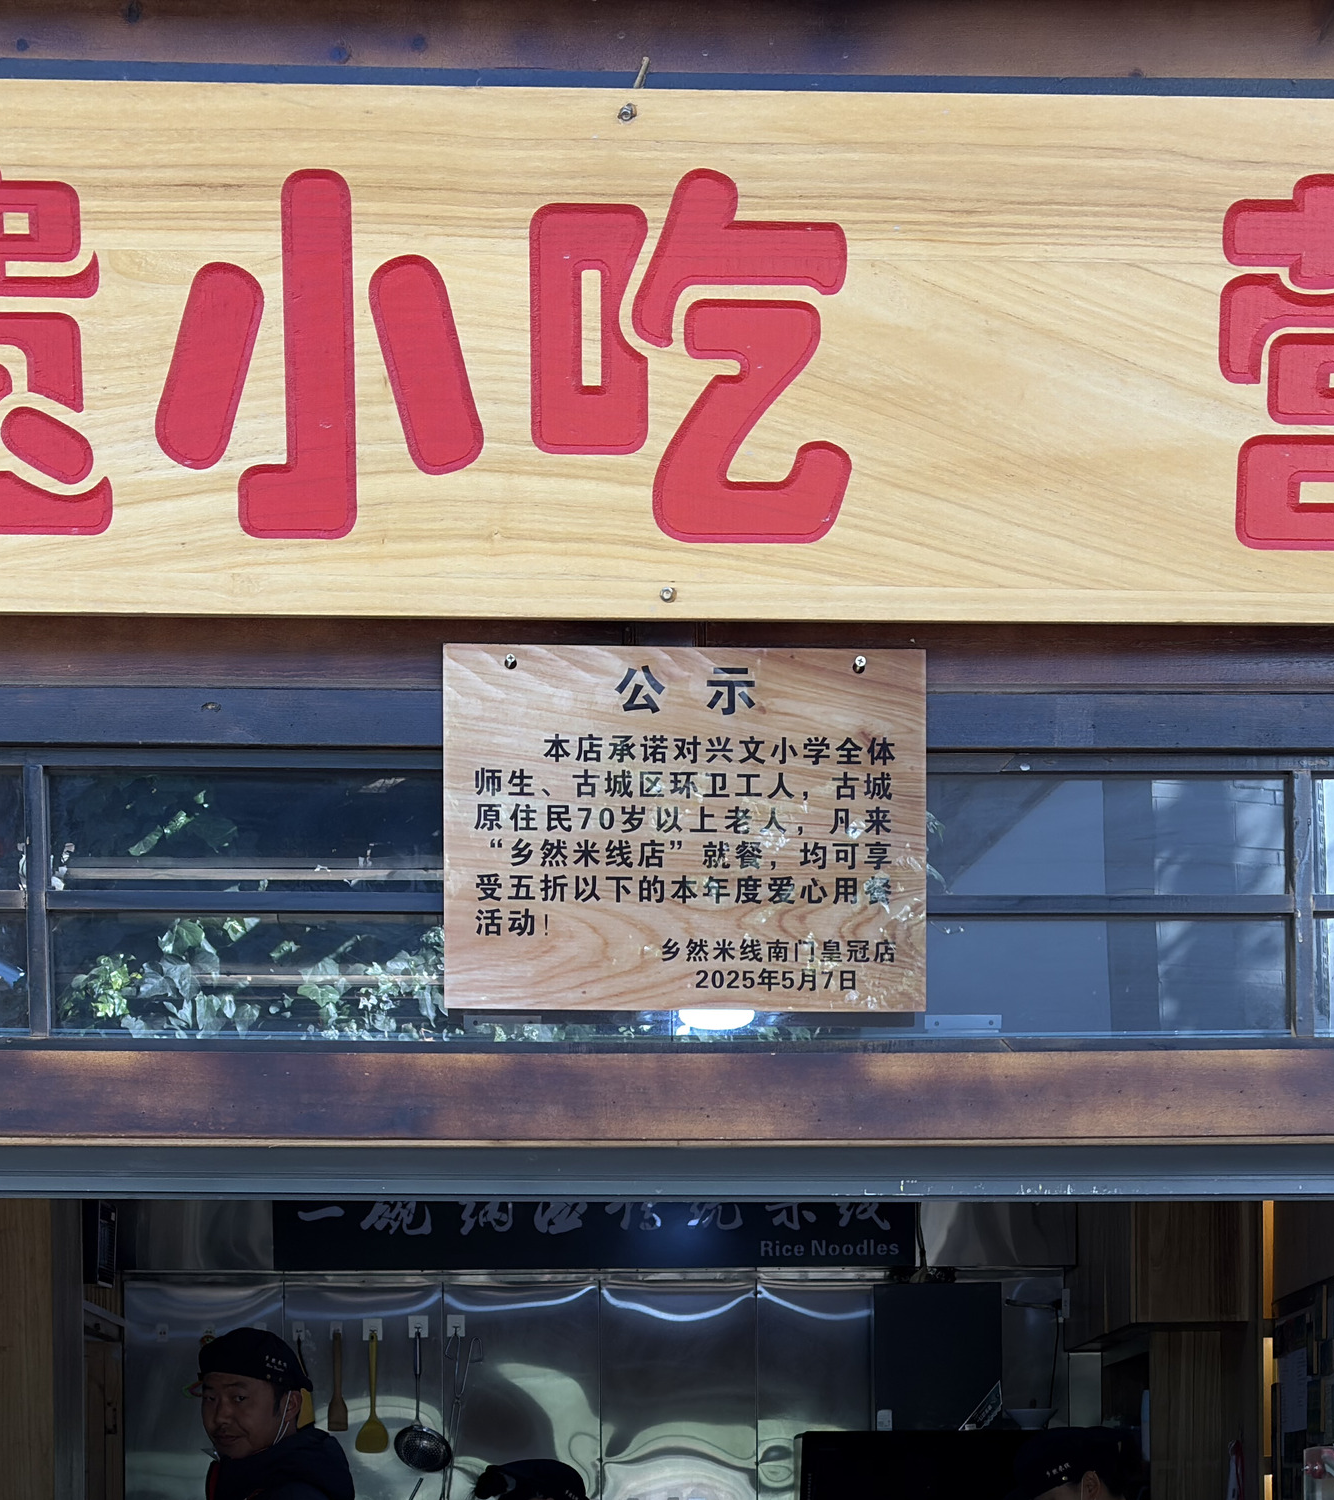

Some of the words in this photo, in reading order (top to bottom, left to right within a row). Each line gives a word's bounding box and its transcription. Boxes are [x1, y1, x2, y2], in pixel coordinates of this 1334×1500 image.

[614, 664, 756, 716] 公示
[543, 733, 896, 766] 本店承诺对兴文小学全体
[474, 768, 892, 801] 师生、古城区环卫工人，古城
[474, 804, 892, 836] 原住民70岁以上老人，凡来
[474, 874, 892, 906] 受五折以下的本年度爱心用餐
[661, 938, 897, 964] 乡然米线南门皇冠店
[695, 968, 857, 992] 2025年5月7日
[759, 1240, 805, 1257] Rice
[810, 1238, 900, 1257] Noodles
